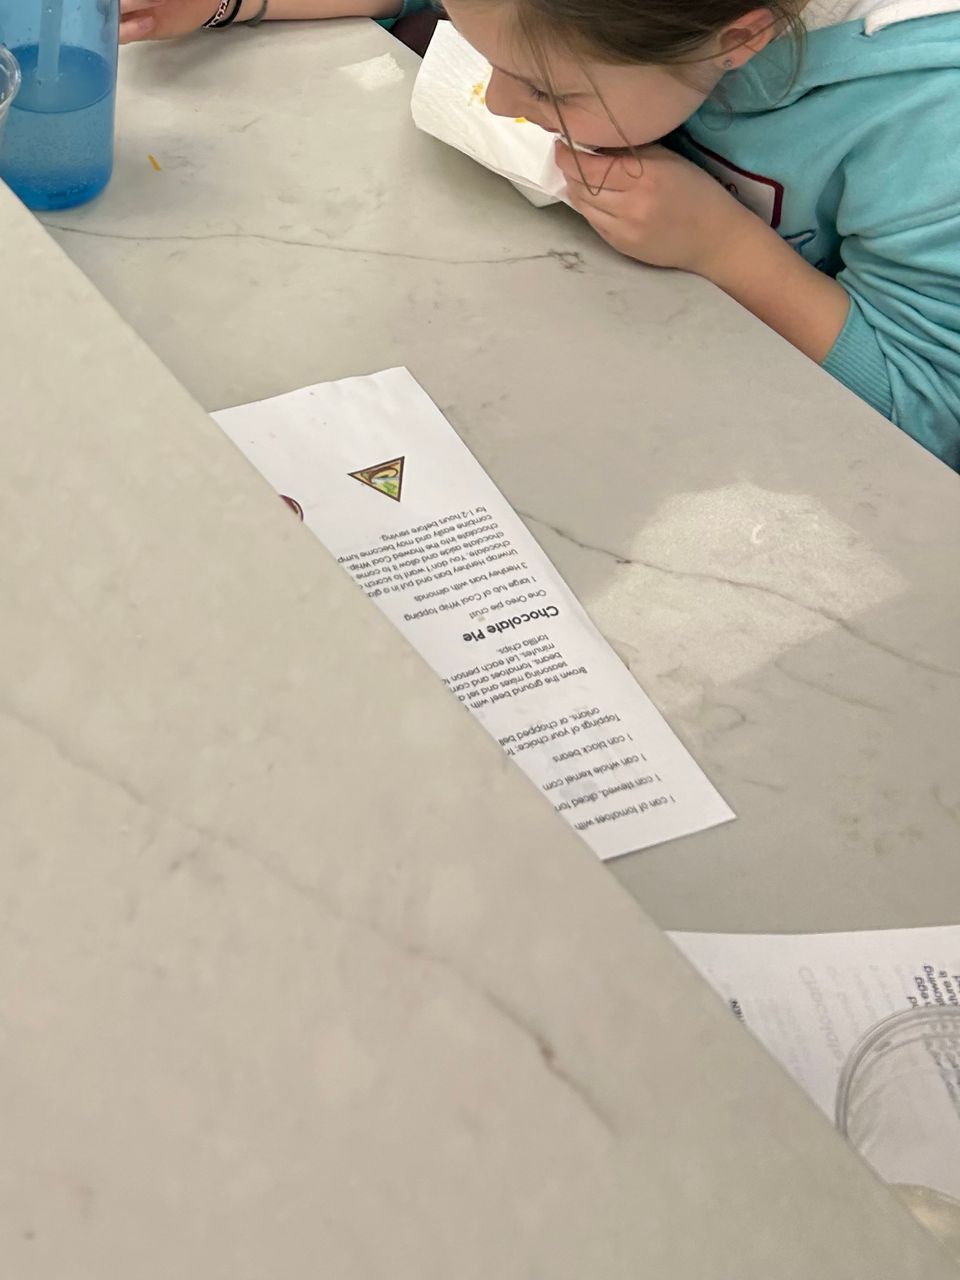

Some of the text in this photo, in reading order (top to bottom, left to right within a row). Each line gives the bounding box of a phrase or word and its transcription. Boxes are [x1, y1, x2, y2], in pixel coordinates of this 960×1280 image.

[475, 506, 487, 514] for
[438, 513, 462, 525] hours
[456, 514, 493, 529] combine
[410, 520, 440, 534] before
[433, 526, 456, 537] easily
[456, 522, 498, 540] chocolate
[395, 539, 415, 548] may
[414, 533, 432, 544] and
[439, 536, 457, 546] into
[462, 531, 505, 549] chocolate
[359, 544, 397, 558] become
[425, 542, 440, 550] the
[439, 544, 462, 556] aside
[392, 546, 426, 561] thawed
[420, 552, 439, 564] and
[449, 554, 468, 564] You
[485, 548, 519, 562] Unwrap
[371, 555, 392, 567] Cool
[398, 558, 421, 569] allow
[425, 560, 449, 573] don't
[452, 559, 486, 573] Hershey
[355, 568, 381, 580] come
[392, 573, 404, 581] to
[403, 567, 426, 579] want
[433, 569, 453, 580] bars
[488, 564, 521, 578] Hershey
[364, 575, 393, 588] scorch
[399, 579, 415, 591] put
[414, 575, 433, 587] and
[468, 574, 489, 585] bars
[507, 577, 531, 588] large
[390, 584, 401, 592] in
[449, 581, 469, 591] with
[492, 584, 509, 593] tub
[413, 587, 450, 602] almonds
[460, 592, 482, 606] Cool
[482, 589, 492, 598] of
[438, 600, 462, 612] Whip
[468, 589, 547, 620] One Oreo pie crust
[403, 607, 439, 622] topping
[462, 605, 559, 642] Chocolate Pie
[497, 634, 550, 654] tortilla chips.
[519, 642, 555, 658] minutes.
[480, 659, 505, 672] each
[505, 654, 521, 665] Let
[450, 666, 481, 682] person
[490, 662, 533, 680] tomatoes
[524, 661, 568, 680] seasoning
[449, 682, 471, 693] corn
[470, 675, 490, 688] and
[470, 666, 588, 709] Brown the ground beef with
[499, 675, 525, 688] mixes
[466, 689, 481, 700] set
[480, 683, 499, 696] and
[559, 717, 569, 726] or
[580, 713, 621, 730] Toppings
[516, 720, 558, 741] chopped
[550, 727, 571, 741] your
[570, 725, 581, 736] of
[498, 734, 517, 746] bell
[514, 735, 550, 752] choice:
[606, 735, 626, 746] can
[581, 740, 608, 754] black
[552, 748, 582, 763] beans
[620, 755, 640, 766] can
[592, 761, 621, 774] whole
[564, 770, 594, 785] kernel
[634, 775, 654, 786] can
[542, 778, 565, 791] corn
[570, 793, 598, 808] diced
[648, 796, 669, 807] can
[638, 802, 649, 813] of
[594, 806, 639, 824] tomatoes
[574, 819, 595, 831] with
